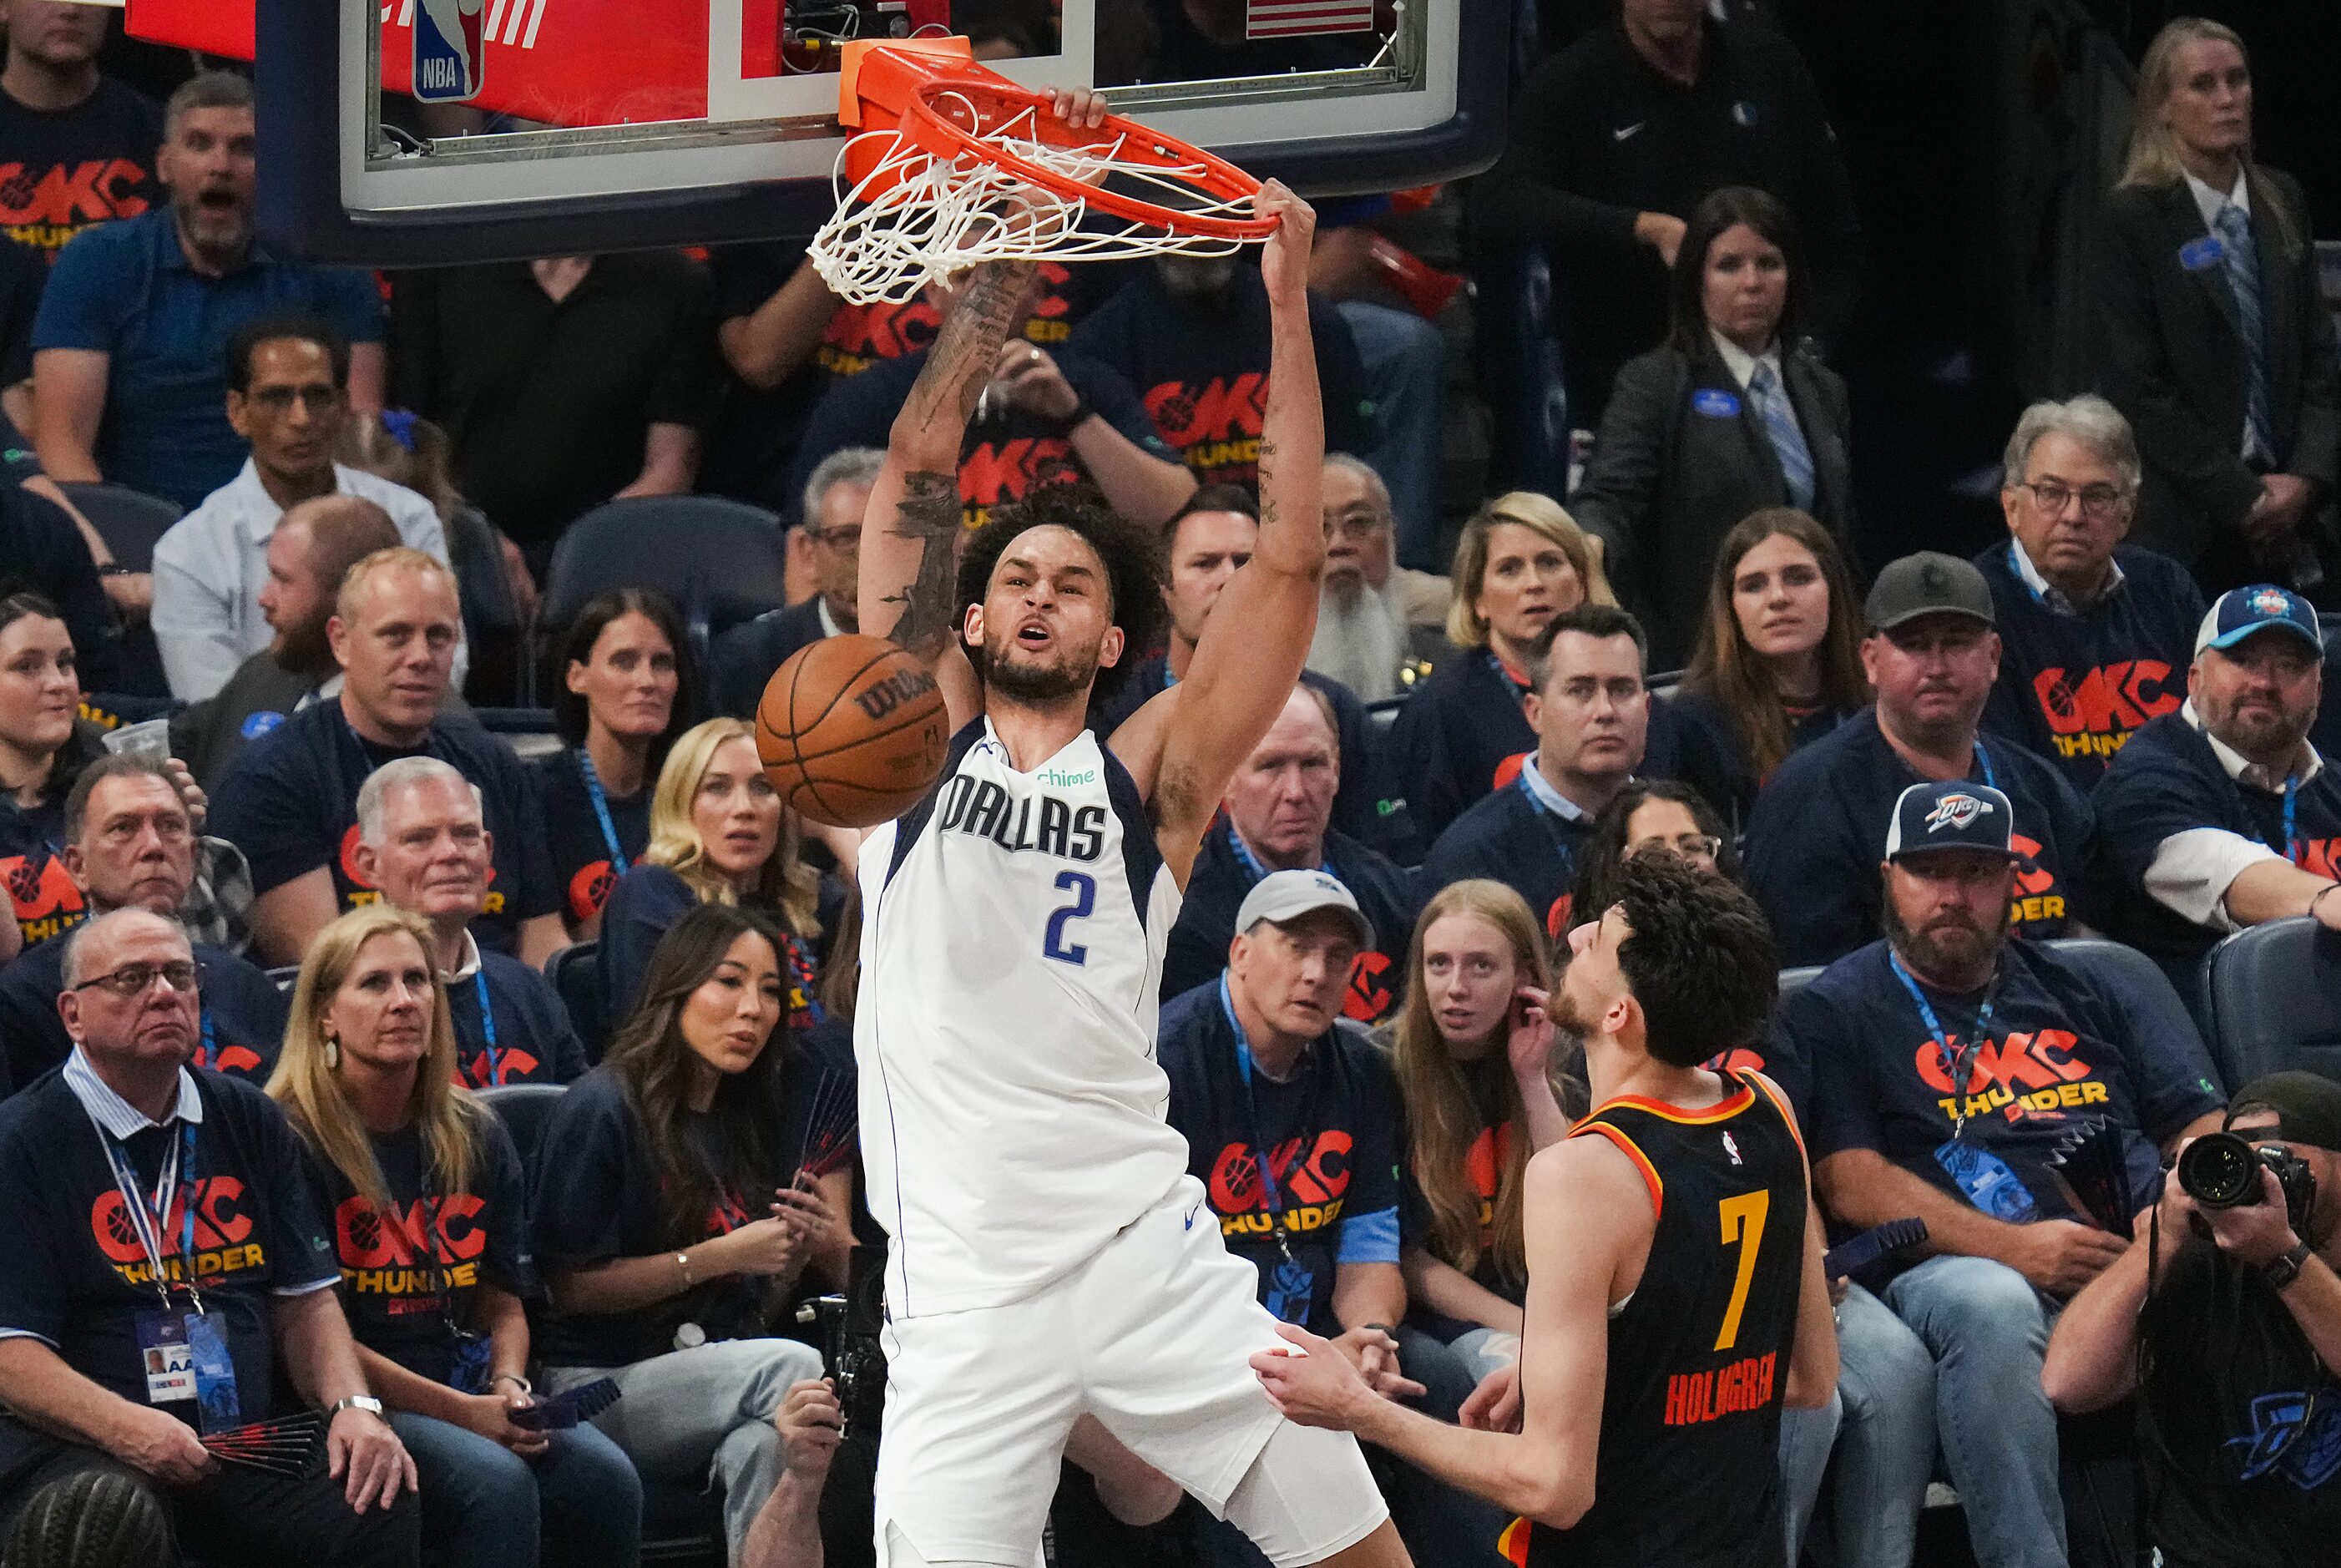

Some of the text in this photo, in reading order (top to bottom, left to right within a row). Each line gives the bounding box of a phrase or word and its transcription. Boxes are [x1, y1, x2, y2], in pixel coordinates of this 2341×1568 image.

[423, 57, 456, 89] NBA
[1144, 373, 1270, 448] OK
[2033, 659, 2182, 733] OKC
[1037, 768, 1095, 787] chime
[939, 773, 1109, 864] DALLAS
[1043, 869, 1098, 968] 2
[1915, 1028, 2091, 1095] OKC
[1210, 1130, 1353, 1214] OKC
[91, 1176, 253, 1263] OKC
[336, 1192, 487, 1268] OKC
[1713, 1189, 1769, 1352] 7
